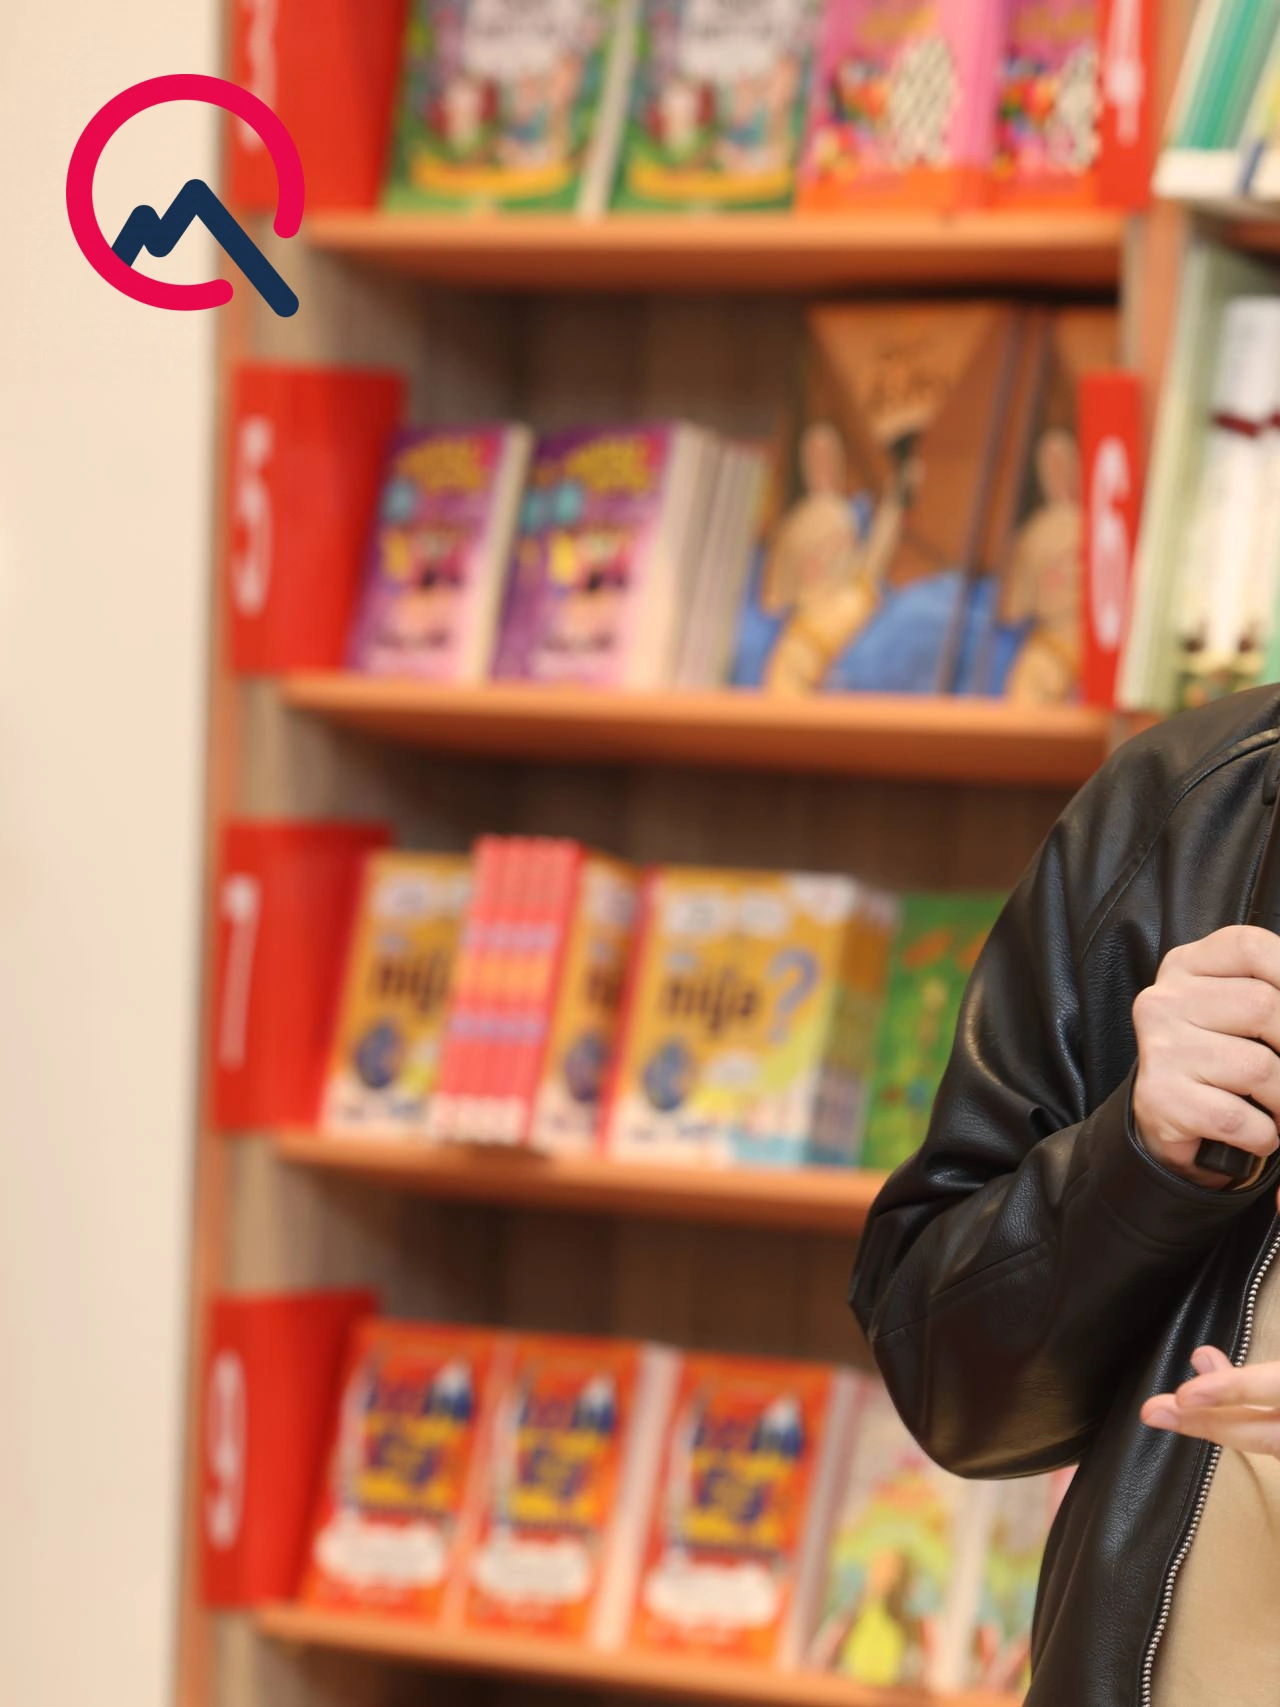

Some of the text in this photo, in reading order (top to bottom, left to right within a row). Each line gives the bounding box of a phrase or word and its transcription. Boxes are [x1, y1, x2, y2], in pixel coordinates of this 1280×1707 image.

[231, 417, 274, 616] 5
[1088, 435, 1132, 652] 6
[206, 1351, 248, 1552] 9
